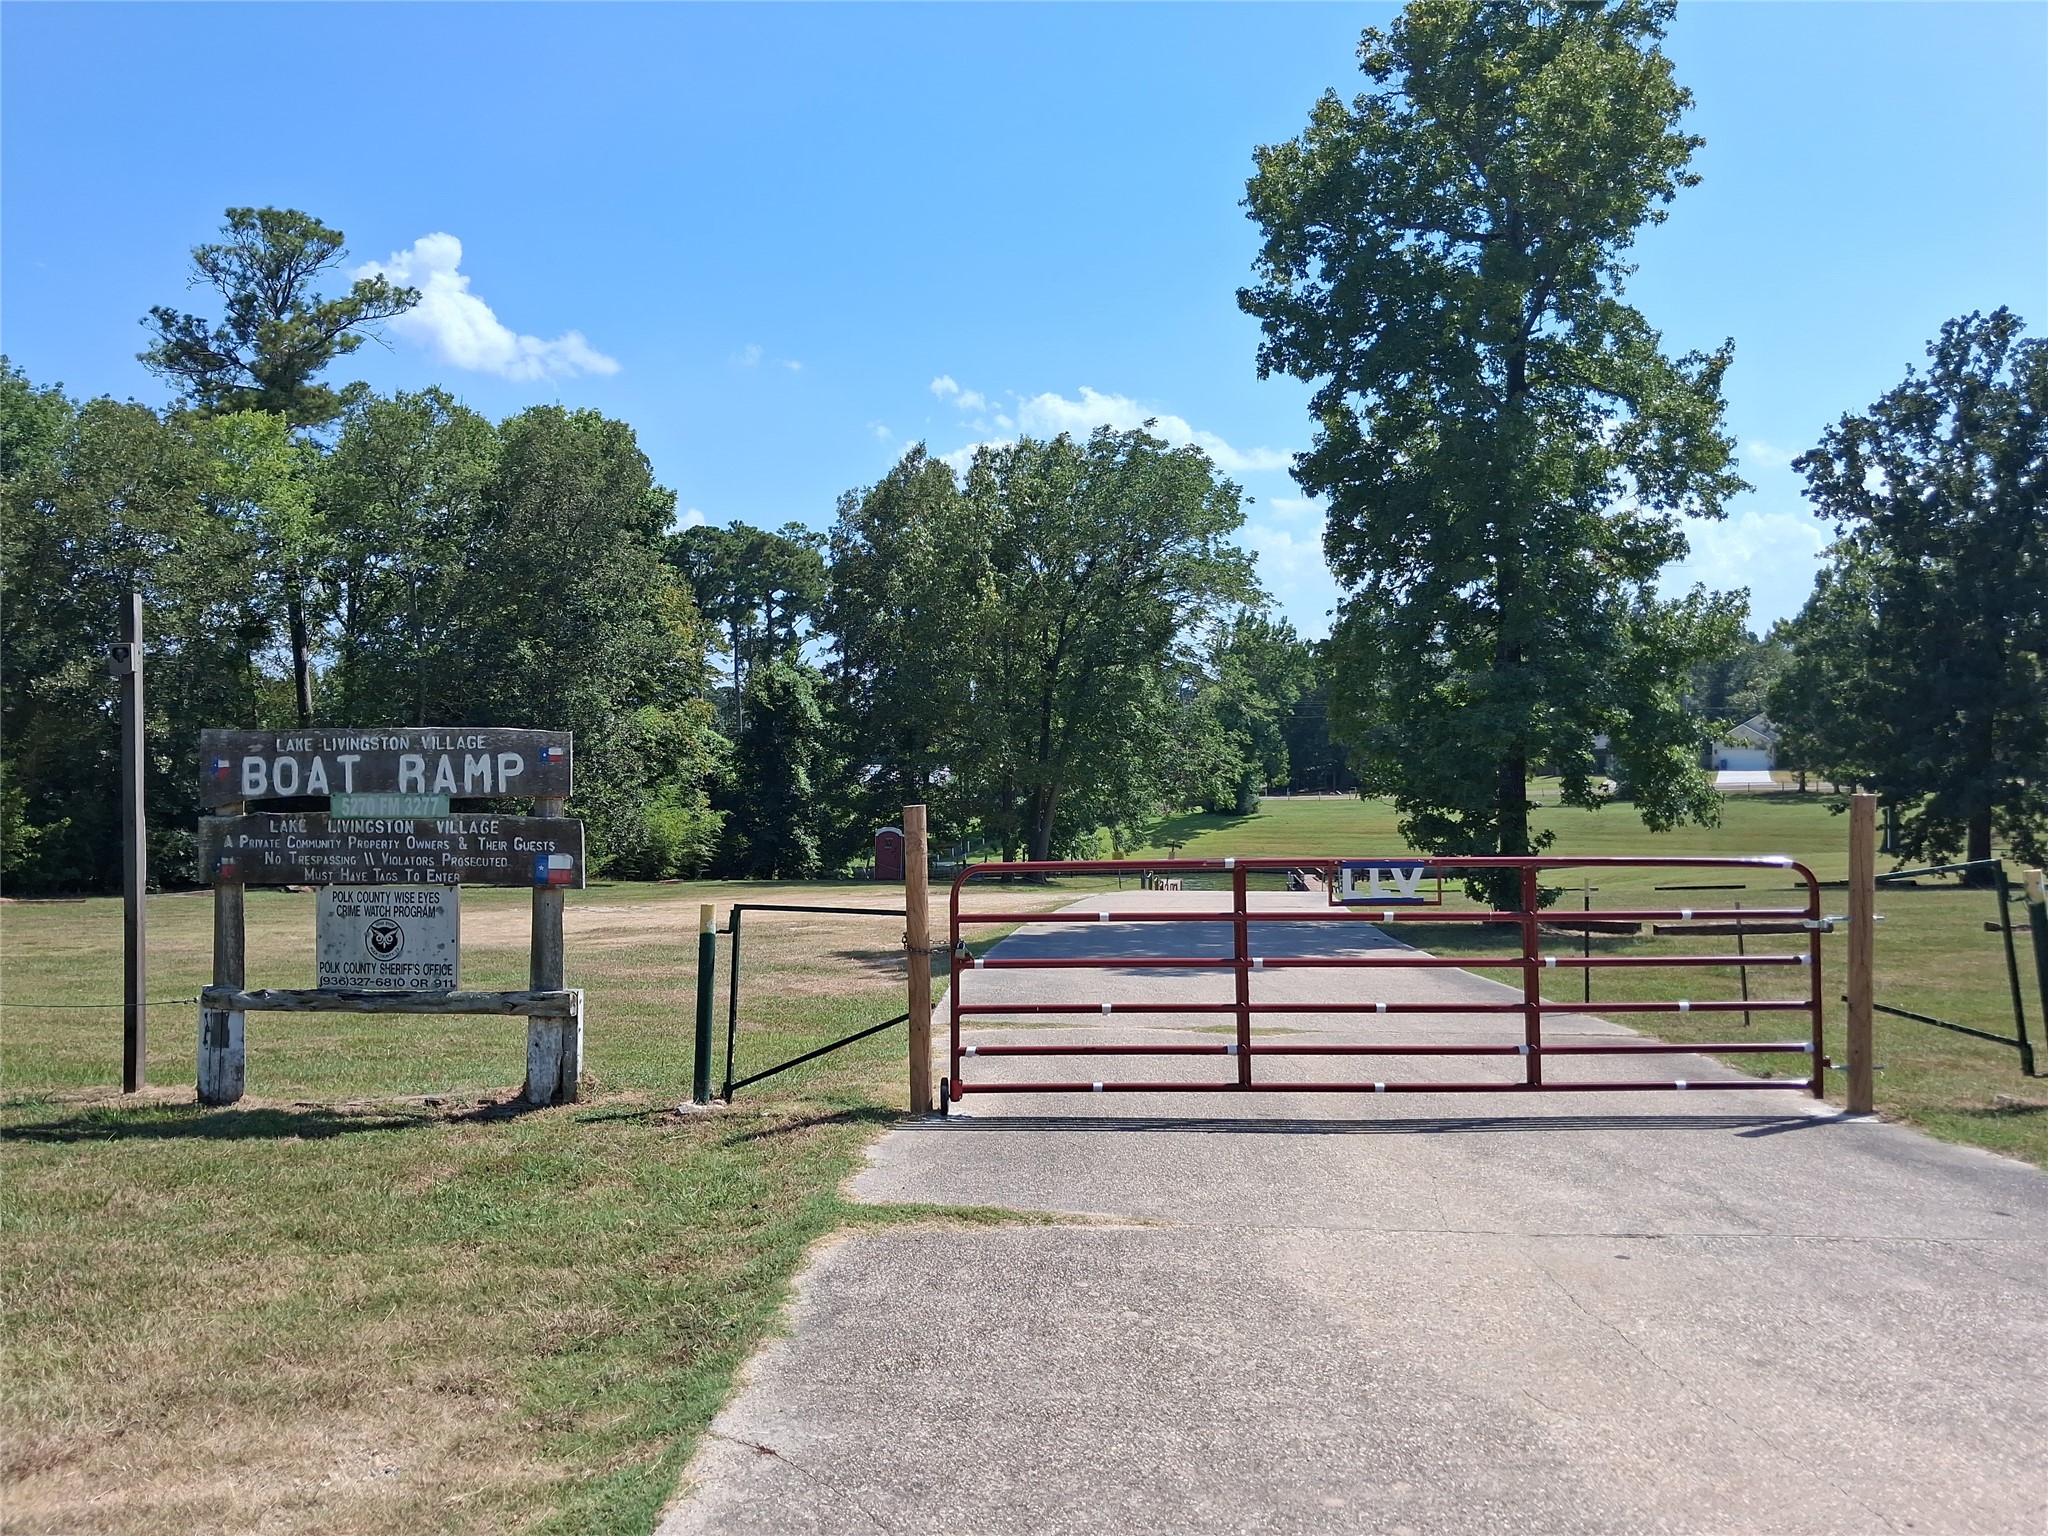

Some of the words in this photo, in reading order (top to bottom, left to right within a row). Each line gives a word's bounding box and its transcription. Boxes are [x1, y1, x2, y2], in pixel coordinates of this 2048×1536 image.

[276, 738, 312, 751] LAKE
[323, 737, 410, 751] LIVINGSTON
[422, 736, 486, 749] VILLAGE
[242, 755, 361, 796] BOAT
[398, 752, 525, 794] RAMP
[342, 797, 376, 815] 5270
[380, 798, 400, 815] FM
[404, 797, 439, 814] 3277
[269, 820, 307, 834] LAKE
[328, 820, 414, 834] LIVINGSTON
[437, 820, 499, 834] VILLAGE
[224, 836, 233, 848] A
[287, 836, 341, 849] COMMUNITY
[349, 837, 400, 850] PROPERTY
[407, 837, 449, 850] OWNERS
[459, 838, 467, 850] &
[478, 837, 507, 851] THEIR
[514, 837, 555, 851] GUESTS
[265, 851, 281, 865] NO
[287, 852, 357, 866] TRESPASSING
[381, 853, 434, 867] VIOLATORS
[305, 868, 335, 881] MUST
[405, 869, 422, 882] TO
[427, 869, 461, 883] ENTER
[1342, 867, 1424, 899] LLV
[333, 891, 353, 903] POLK
[357, 892, 391, 904] COUNTY
[394, 892, 414, 903] WISE
[418, 892, 440, 903] EYES
[337, 905, 360, 917] CRIME
[364, 905, 390, 917] WATCH
[394, 906, 435, 918] PROGRAM
[320, 962, 340, 973] POLK
[344, 962, 376, 975] COUNTY
[380, 963, 420, 975] SHERIFF'S
[423, 964, 452, 976] OFFICE
[320, 977, 405, 988] (936)327-6810
[410, 979, 428, 988] OR
[434, 979, 453, 988] 911
